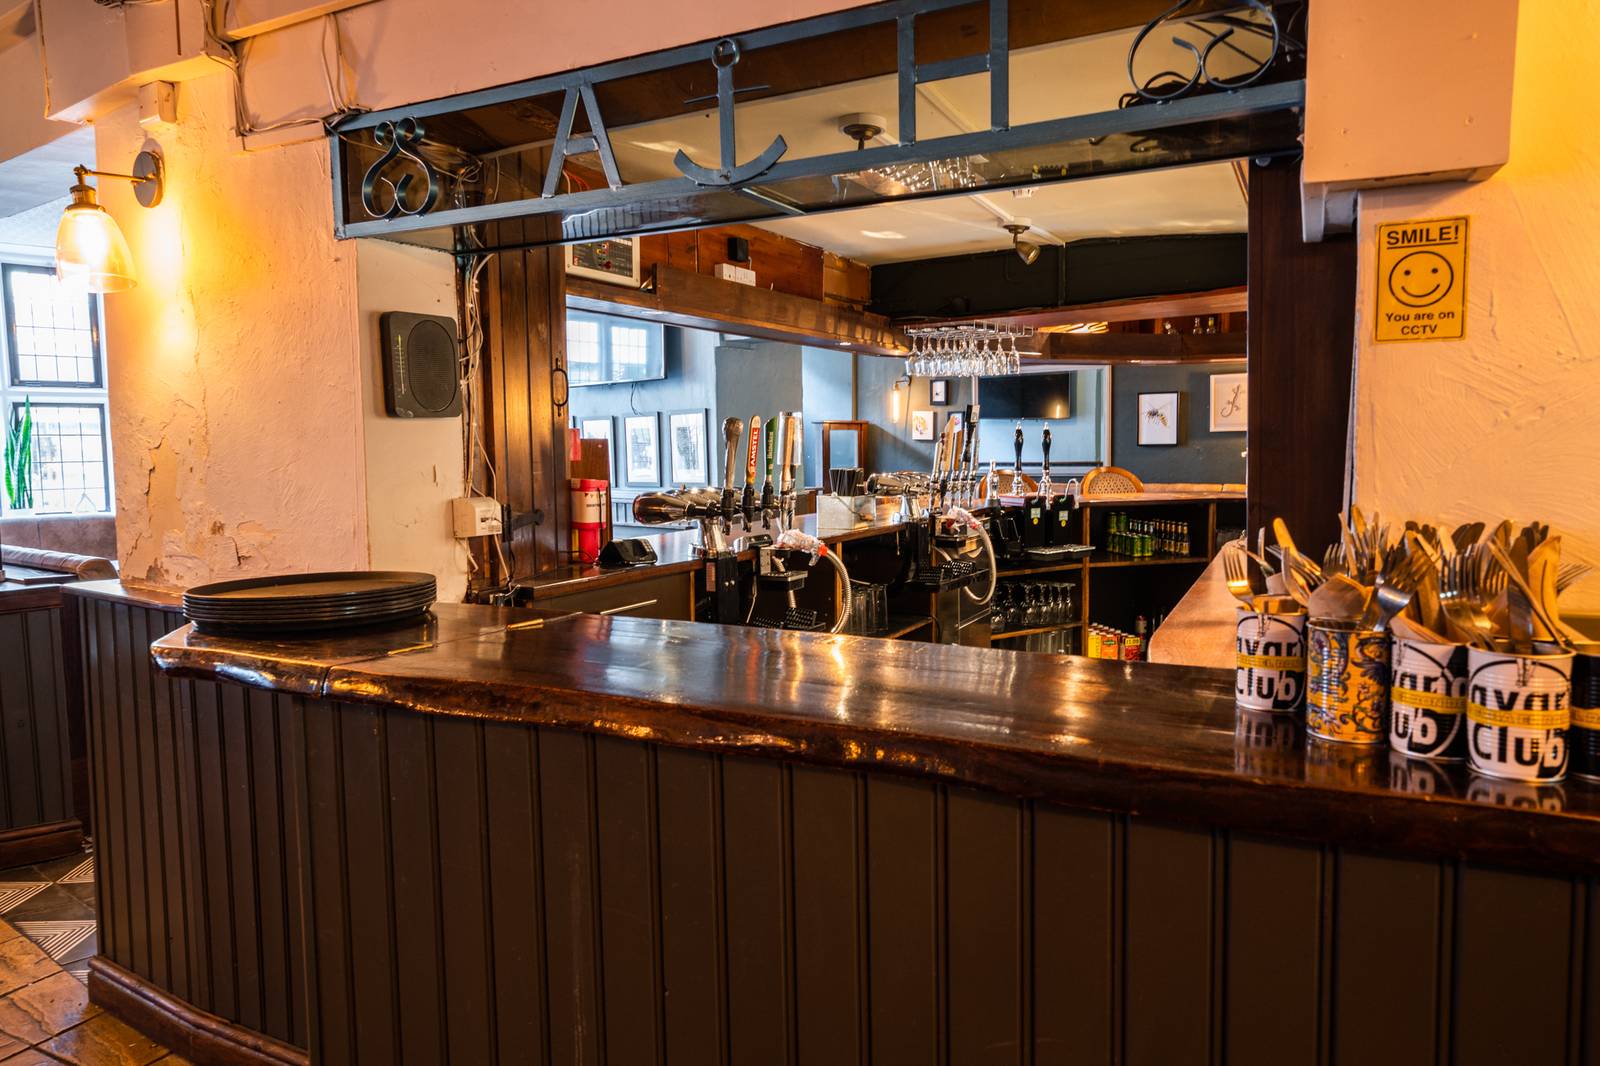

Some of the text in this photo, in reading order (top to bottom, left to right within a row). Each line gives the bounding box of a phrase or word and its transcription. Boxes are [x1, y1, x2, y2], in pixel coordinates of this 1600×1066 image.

[1386, 225, 1459, 246] SMILE!
[1385, 310, 1455, 322] You are on
[1401, 324, 1438, 335] CCTV
[750, 429, 760, 466] AMSTEL
[1472, 722, 1565, 768] Club
